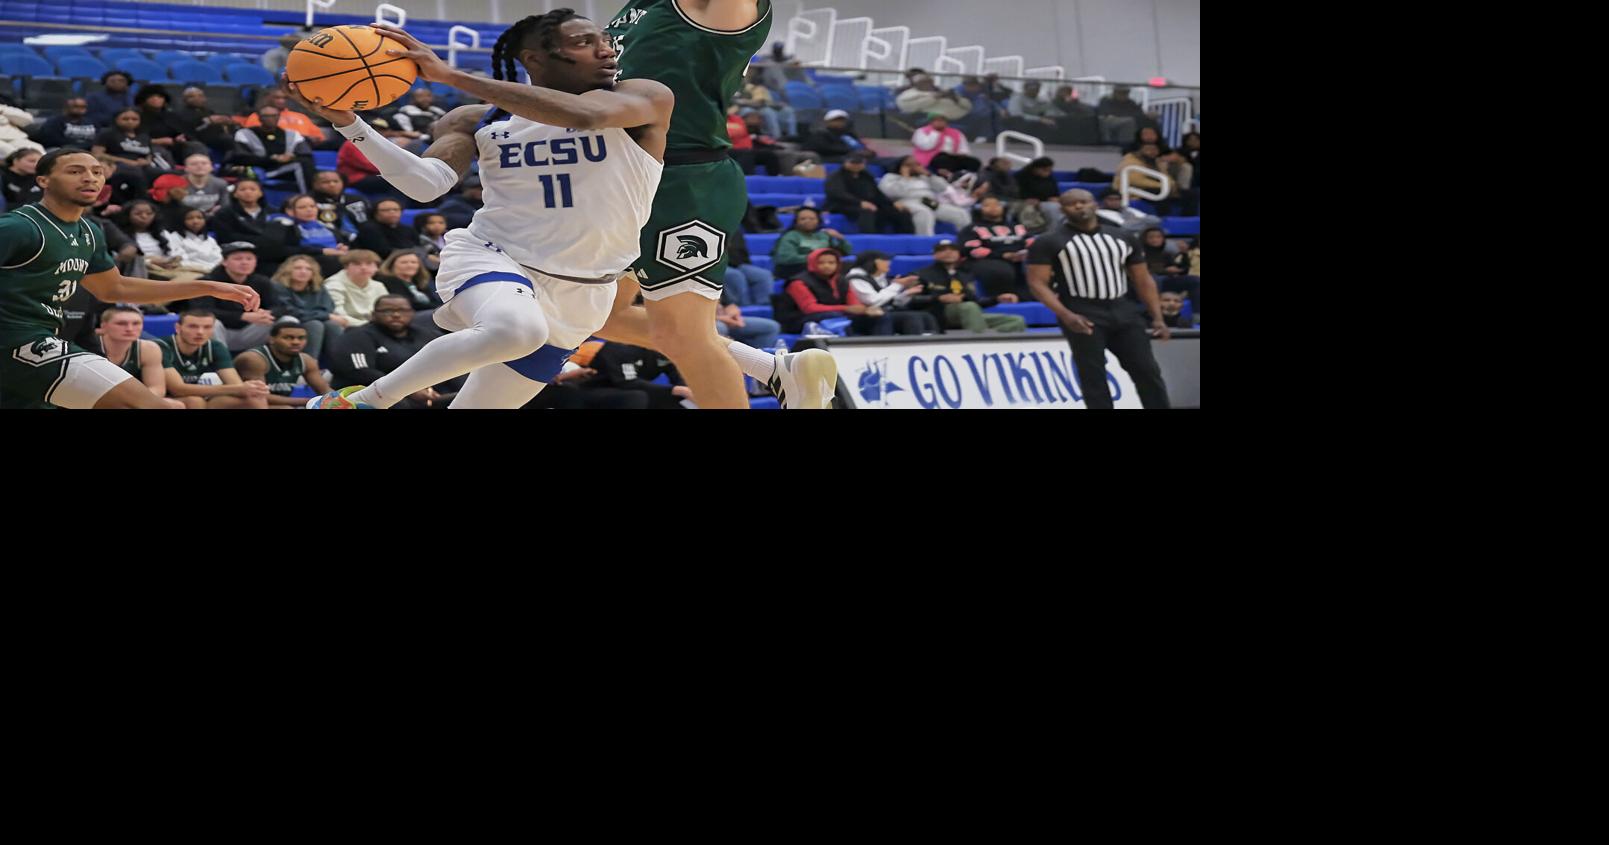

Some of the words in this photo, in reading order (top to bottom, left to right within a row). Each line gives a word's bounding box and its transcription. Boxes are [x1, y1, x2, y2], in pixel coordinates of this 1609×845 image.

[498, 135, 607, 168] ECSU
[538, 173, 574, 208] 11
[54, 258, 89, 275] MOUNT
[908, 354, 962, 409] GO
[961, 350, 1122, 408] VIKINS
